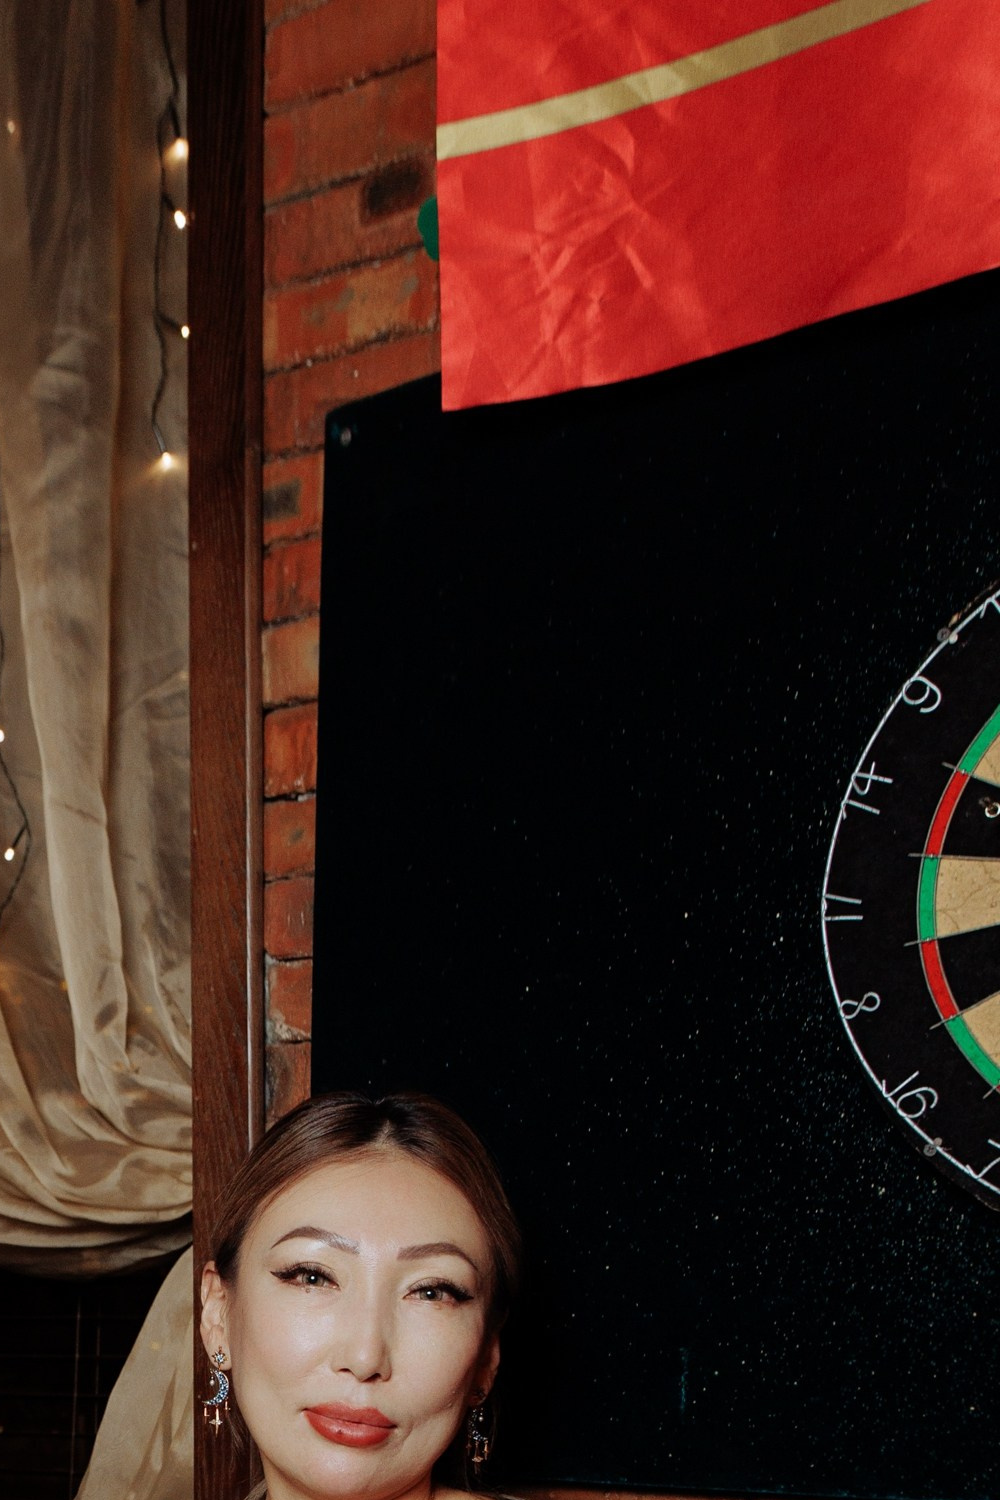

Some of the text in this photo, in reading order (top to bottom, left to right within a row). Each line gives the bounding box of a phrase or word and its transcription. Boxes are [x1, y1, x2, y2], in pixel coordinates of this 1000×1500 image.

[902, 675, 942, 714] 9
[840, 761, 894, 820] 14
[840, 991, 881, 1020] 8
[881, 1070, 938, 1119] 16
